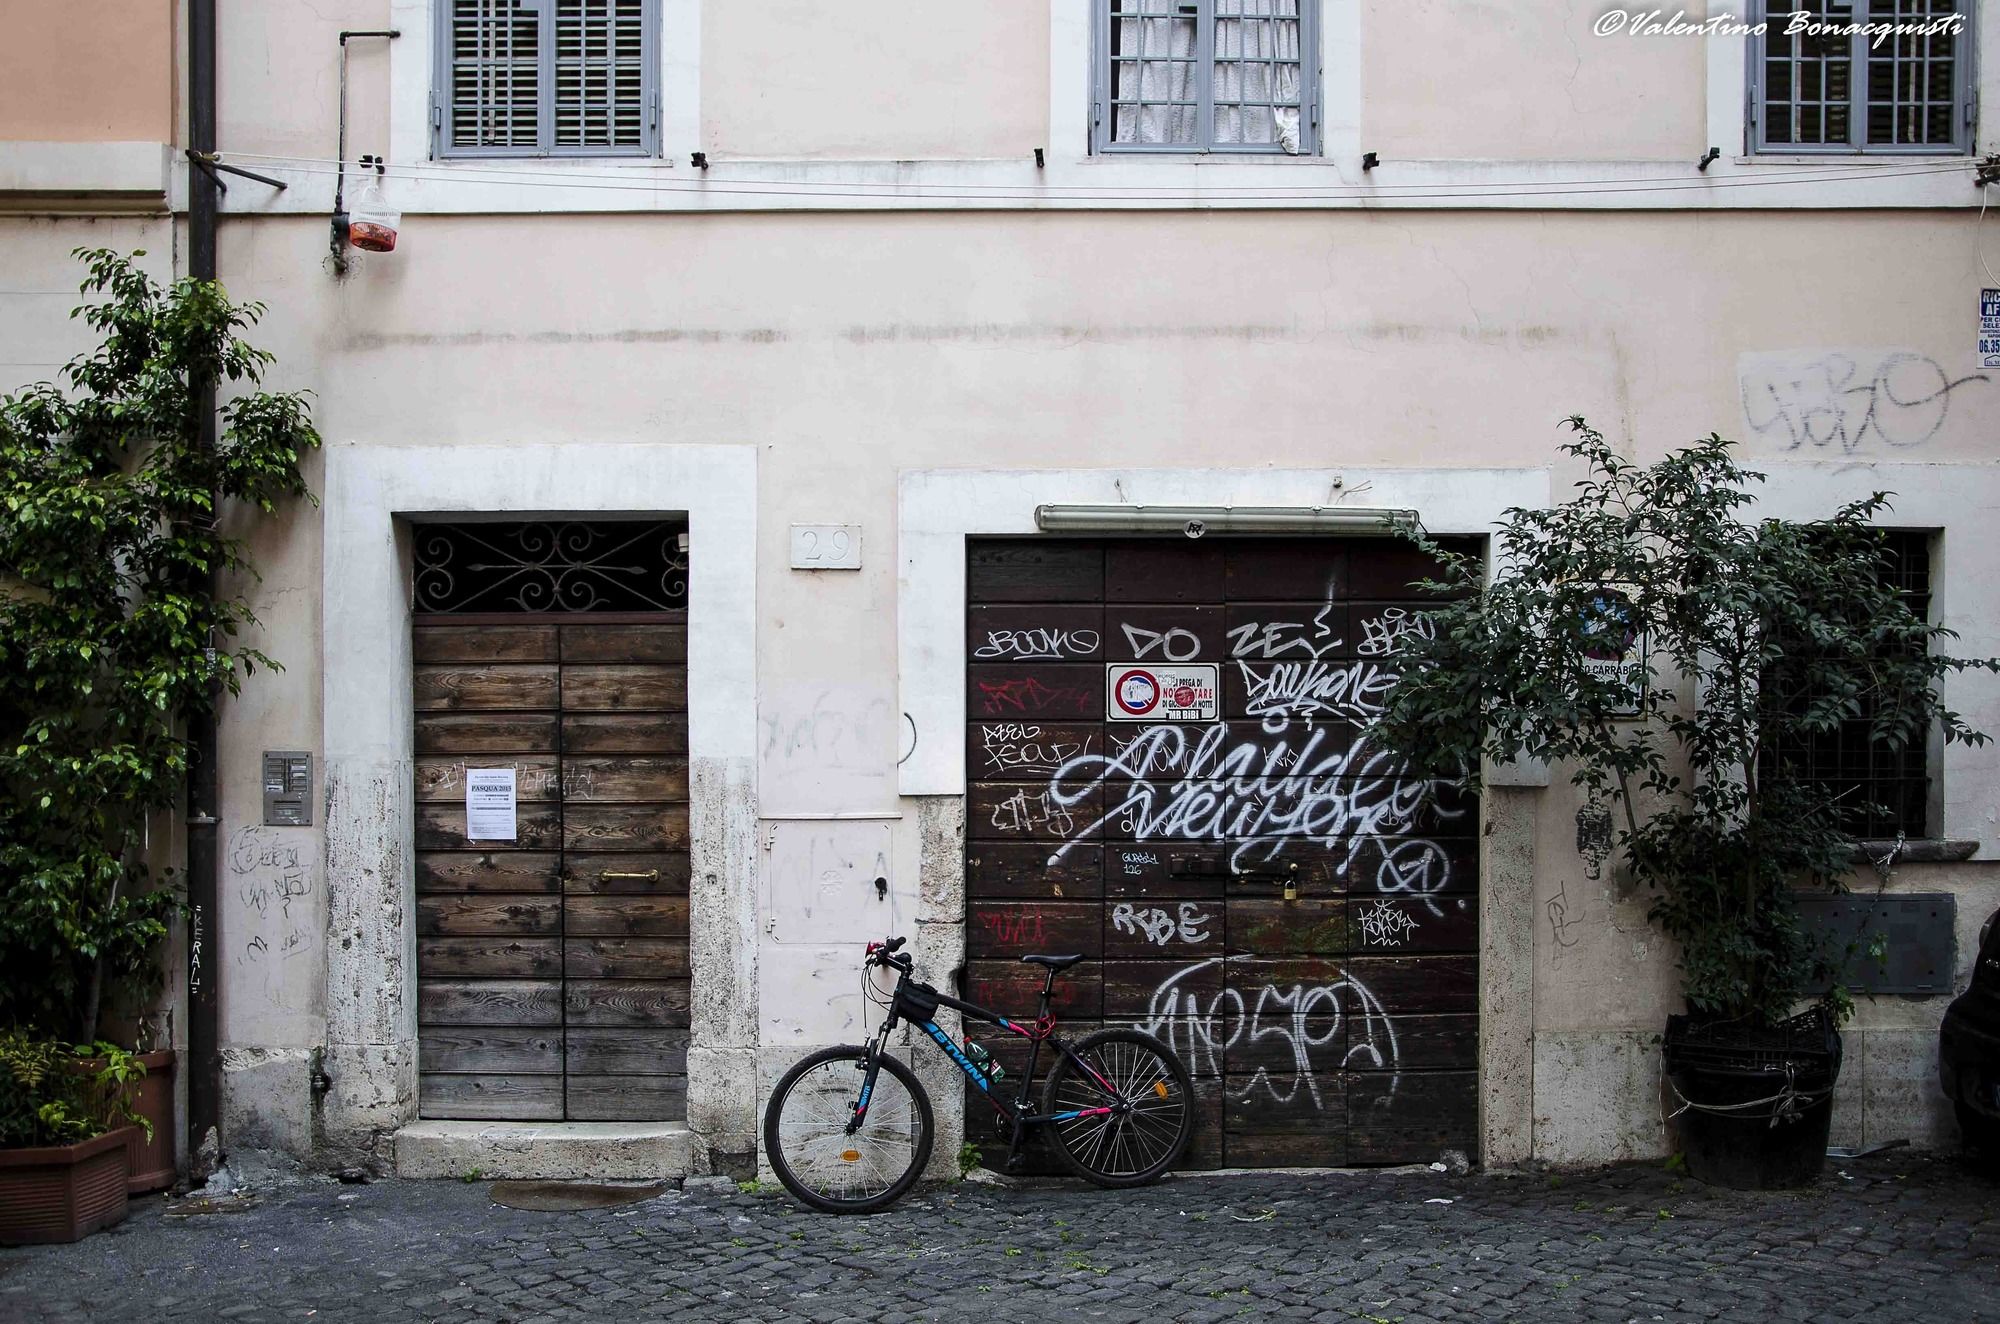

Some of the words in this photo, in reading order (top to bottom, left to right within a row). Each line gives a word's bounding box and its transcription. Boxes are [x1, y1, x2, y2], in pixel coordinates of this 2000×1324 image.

[802, 530, 849, 560] 29
[1179, 678, 1196, 687] PREGA
[1197, 678, 1203, 687] DI
[1163, 688, 1176, 698] NO
[1198, 700, 1213, 708] NOTTE
